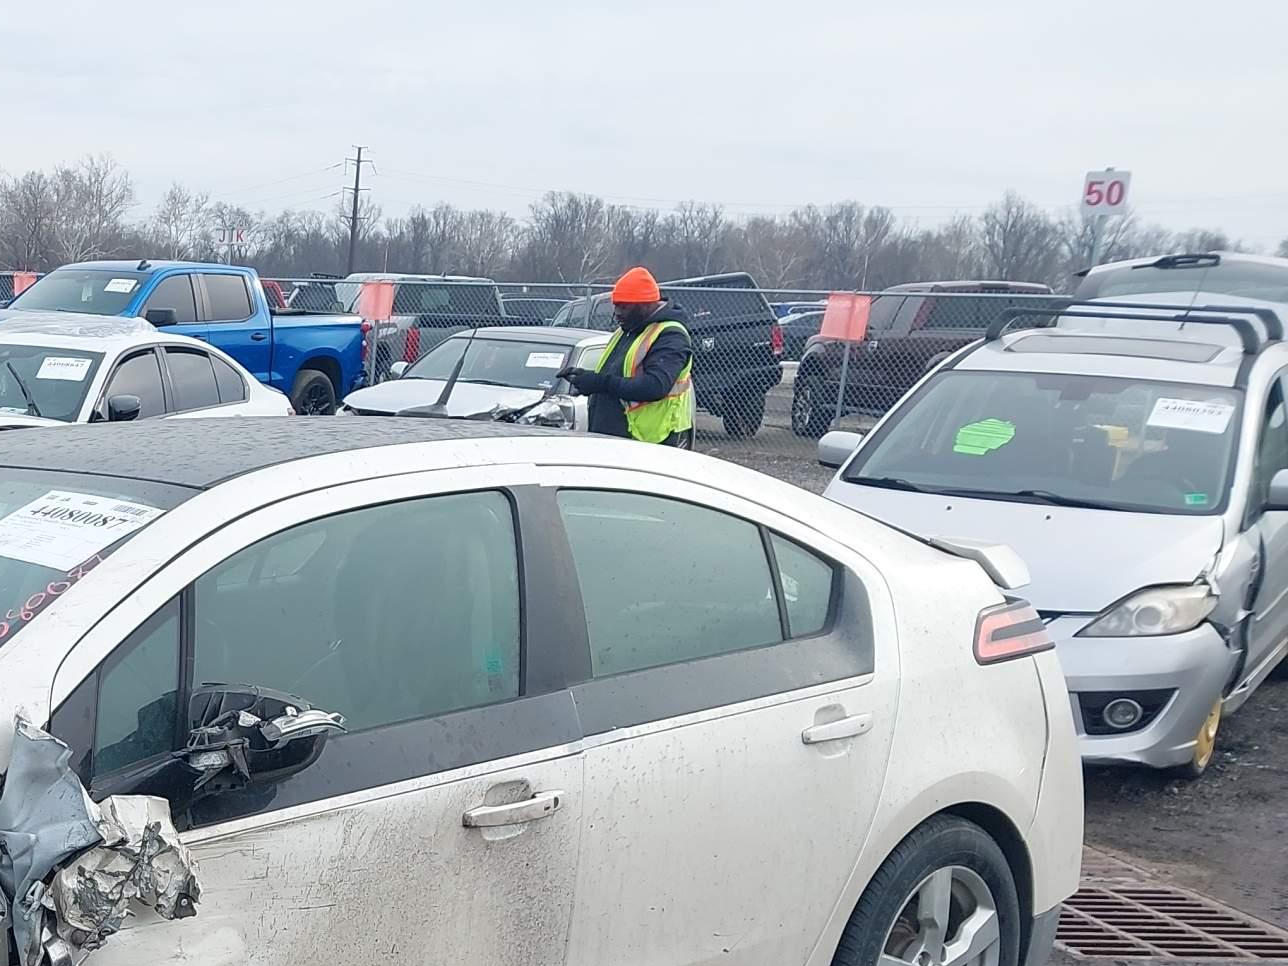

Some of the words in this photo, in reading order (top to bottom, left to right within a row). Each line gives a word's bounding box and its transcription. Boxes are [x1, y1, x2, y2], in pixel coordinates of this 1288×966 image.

[1085, 180, 1124, 206] 50
[236, 229, 244, 243] K
[30, 504, 129, 530] 44080087
